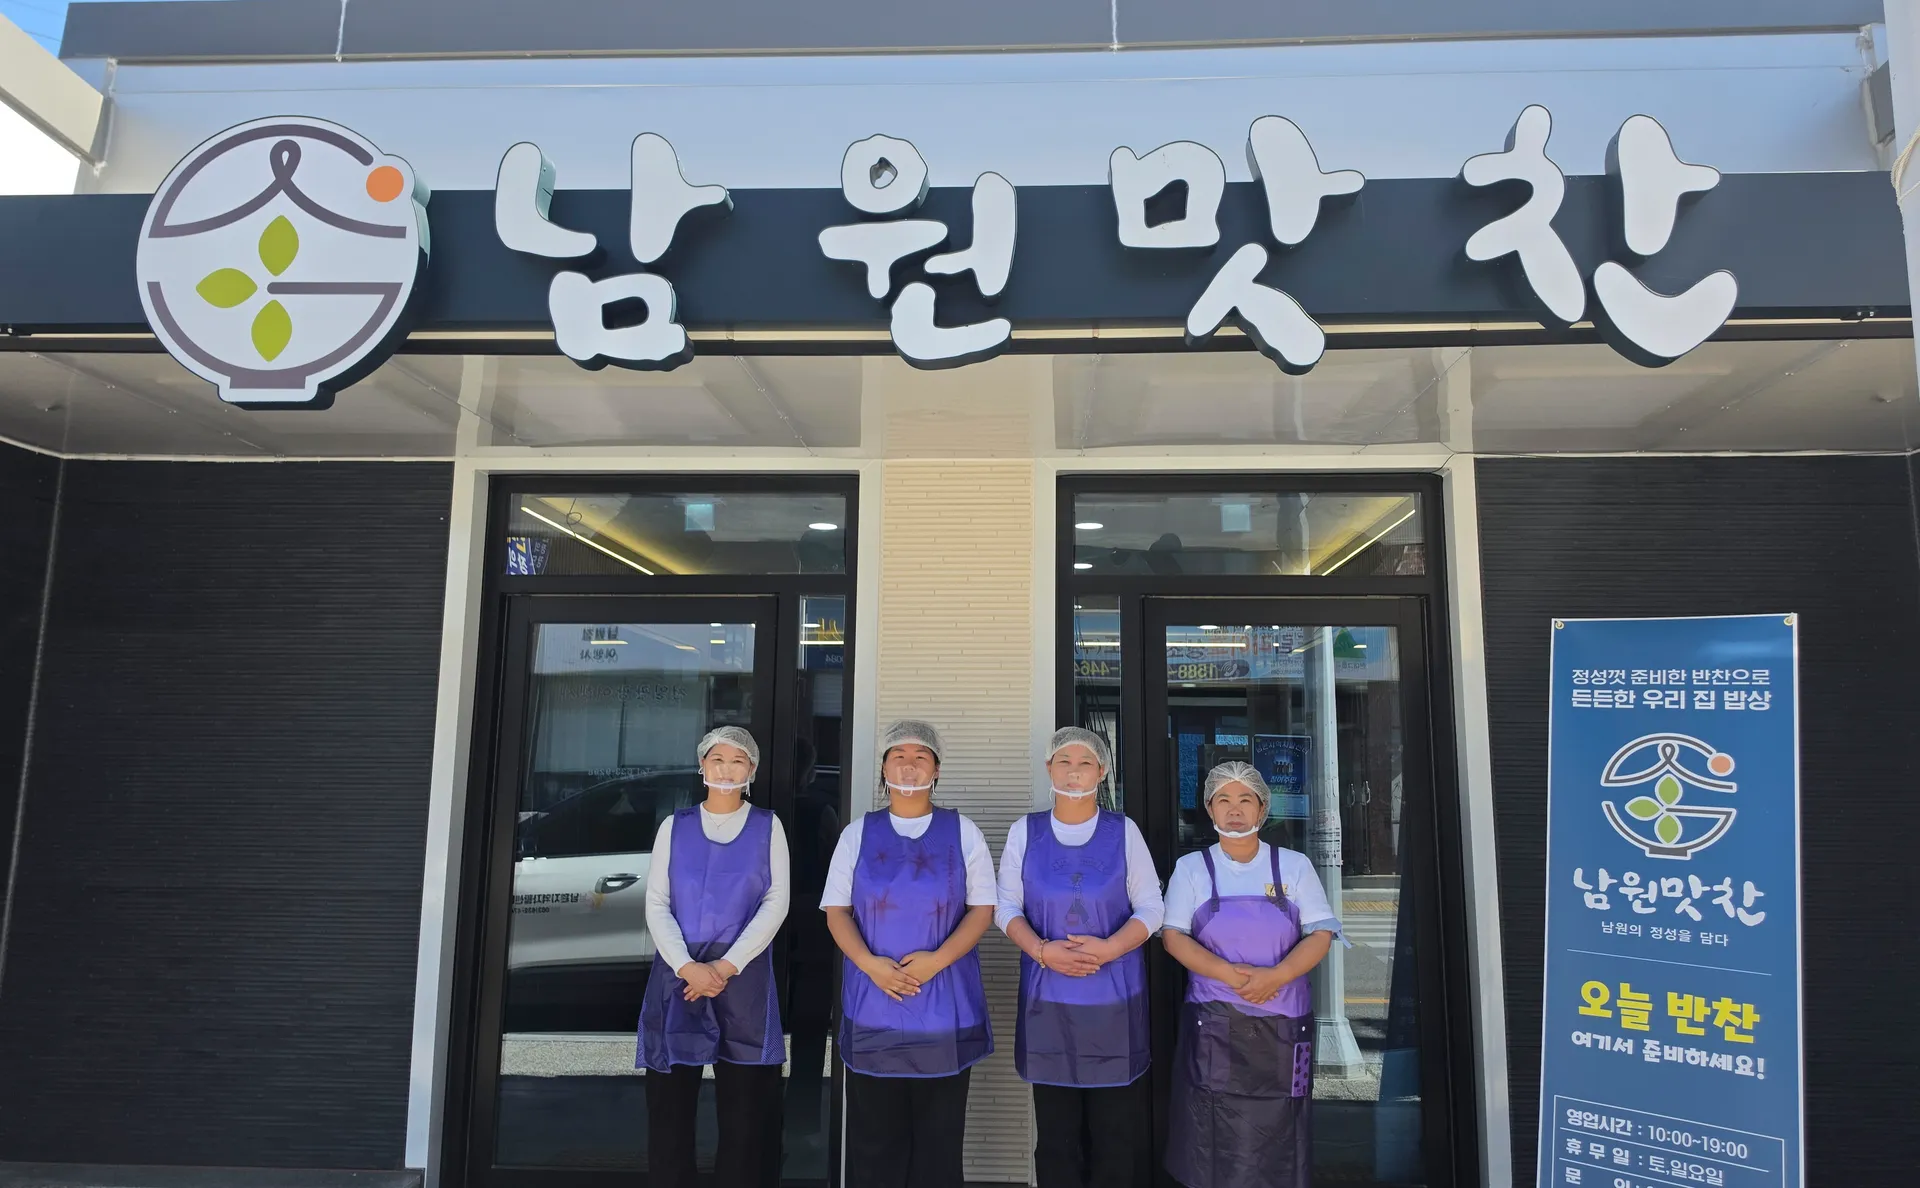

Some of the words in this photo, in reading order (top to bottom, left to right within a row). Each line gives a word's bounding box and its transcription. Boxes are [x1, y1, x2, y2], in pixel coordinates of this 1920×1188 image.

[494, 103, 1740, 369] 남원맛찬
[1571, 689, 1636, 709] 든든한
[1642, 689, 1686, 710] 우리
[1693, 690, 1716, 710] 집
[1723, 690, 1772, 711] 밥상
[1572, 669, 1626, 686] 정성껏
[1630, 668, 1687, 685] 준비한
[1692, 668, 1771, 686] 반찬으로
[1573, 867, 1766, 927] 남원맛찬
[1601, 921, 1642, 937] 남원의
[1650, 926, 1692, 943] 정성을
[1700, 931, 1729, 947] 담다
[1578, 980, 1653, 1032] 오늘
[1666, 991, 1760, 1044] 반찬
[1571, 1030, 1634, 1055] 여기서
[1642, 1038, 1765, 1080] 준비하세요!
[1566, 1108, 1633, 1137] 영업시간
[1648, 1125, 1748, 1160] 10:00~19:00
[1648, 1155, 1724, 1187] 토,일요일
